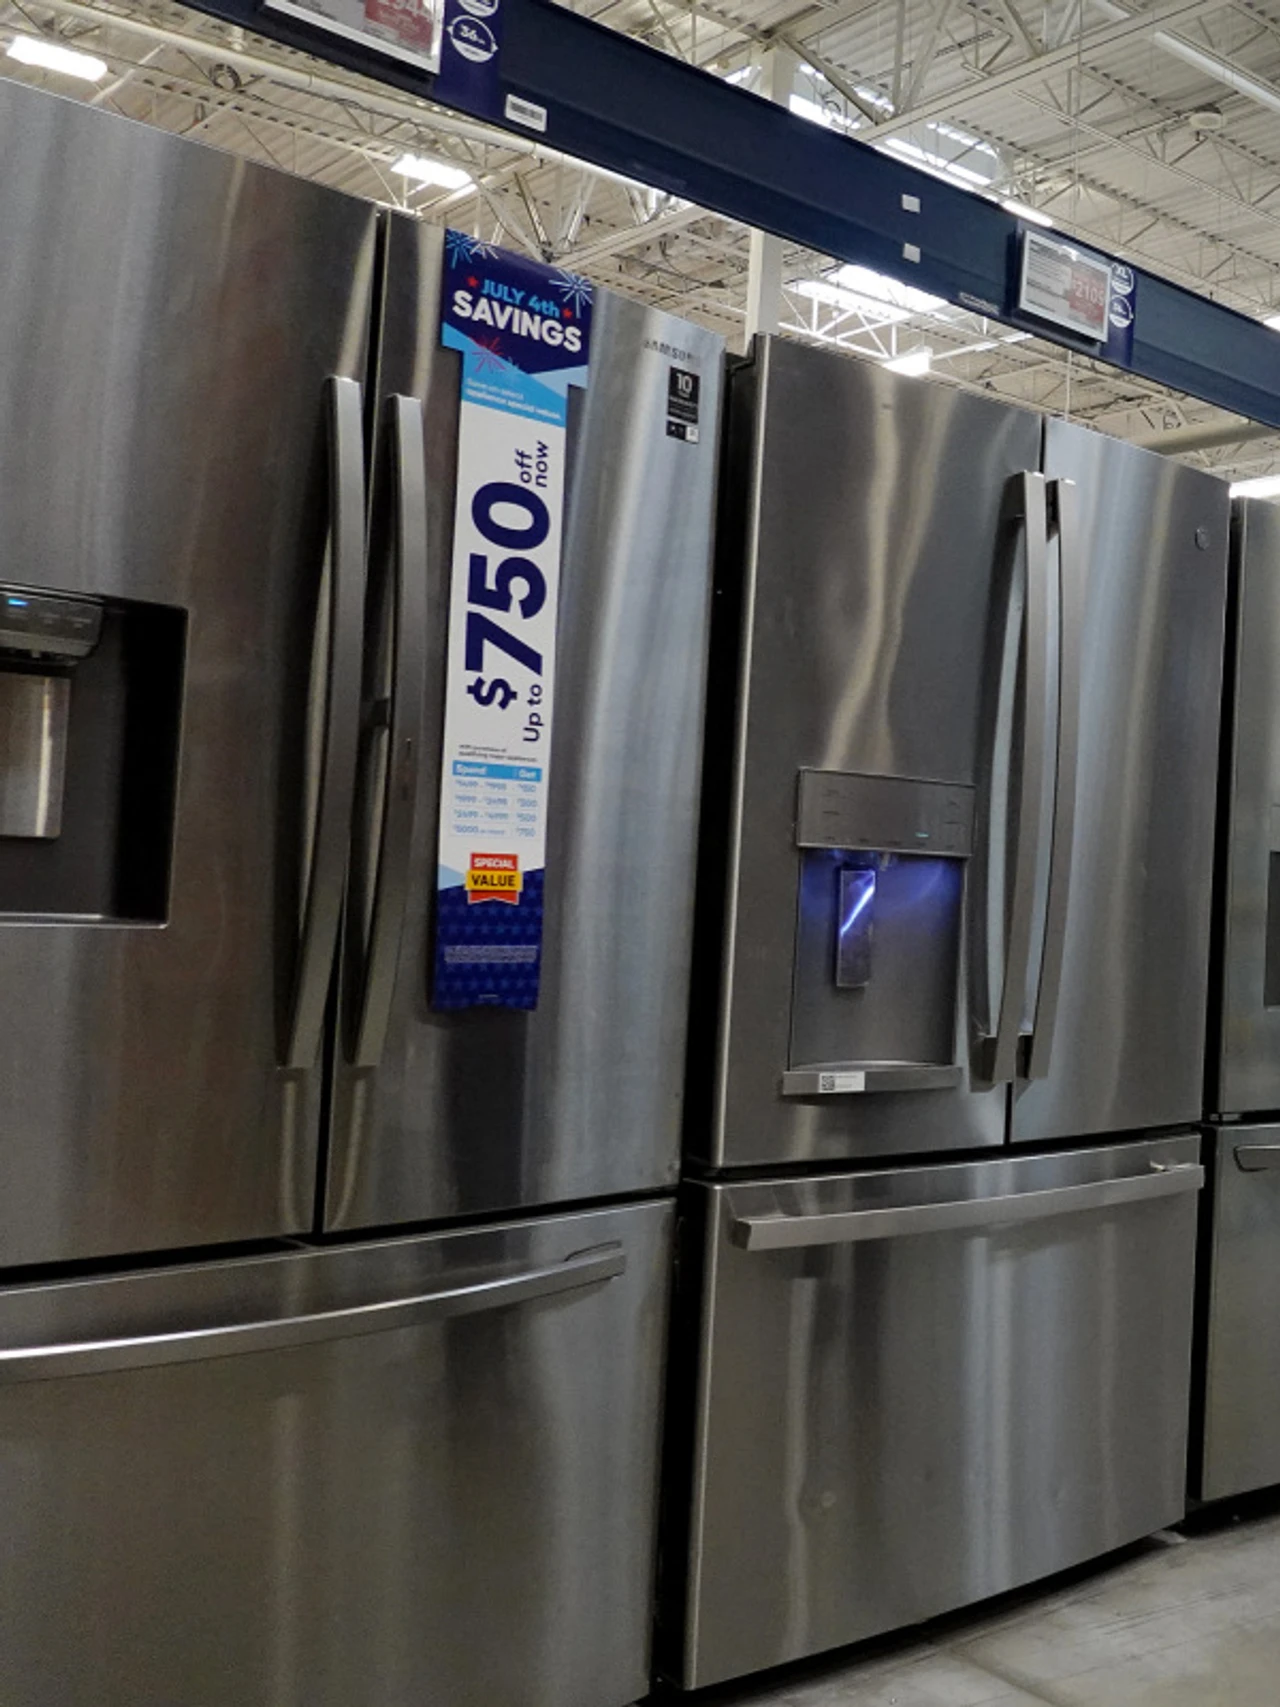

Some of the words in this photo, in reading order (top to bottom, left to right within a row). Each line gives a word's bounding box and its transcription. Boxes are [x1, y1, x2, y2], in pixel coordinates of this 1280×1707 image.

[481, 279, 525, 306] JULY
[528, 295, 560, 318] 4th
[452, 290, 582, 352] SAVINGS
[515, 449, 532, 484] off
[535, 441, 549, 487] now
[464, 481, 550, 710] $750
[529, 684, 543, 706] to
[523, 712, 543, 742] Up
[471, 874, 516, 886] VALUE
[473, 858, 514, 869] SPECIAL
